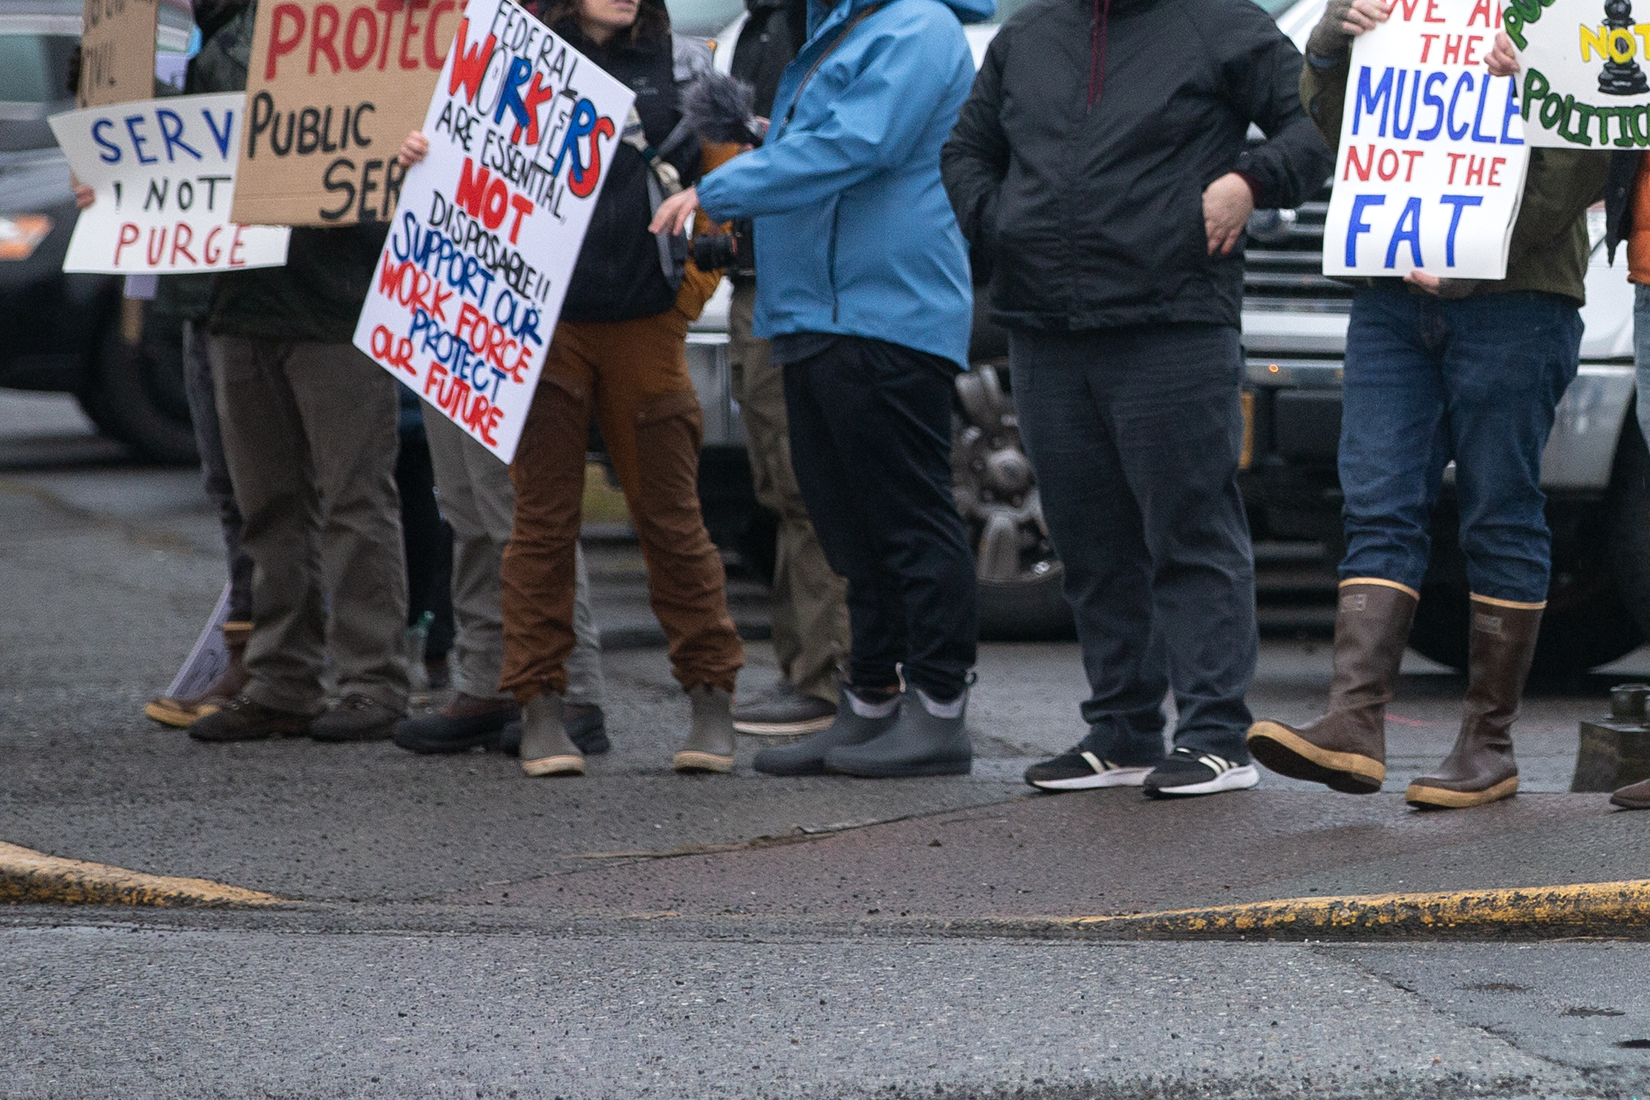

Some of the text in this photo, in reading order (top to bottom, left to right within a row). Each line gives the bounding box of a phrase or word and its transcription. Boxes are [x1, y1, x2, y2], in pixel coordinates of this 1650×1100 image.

[1420, 33, 1484, 66] THE
[91, 107, 235, 164] SERV
[436, 100, 480, 151] ARE
[449, 17, 616, 198] WORKERS
[1351, 65, 1525, 145] MUSCLE
[143, 174, 232, 211] NOT
[455, 157, 534, 245] NOT
[1343, 144, 1507, 187] NOT THE
[113, 220, 251, 268] PURGE
[429, 189, 550, 306] DISPOSABLE!!
[1345, 194, 1484, 270] FAT
[379, 250, 533, 384] WORK FORCE
[393, 211, 543, 346] SUPPORT OUR
[370, 324, 504, 448] OUR FUTURE
[409, 307, 507, 403] PROTECT
